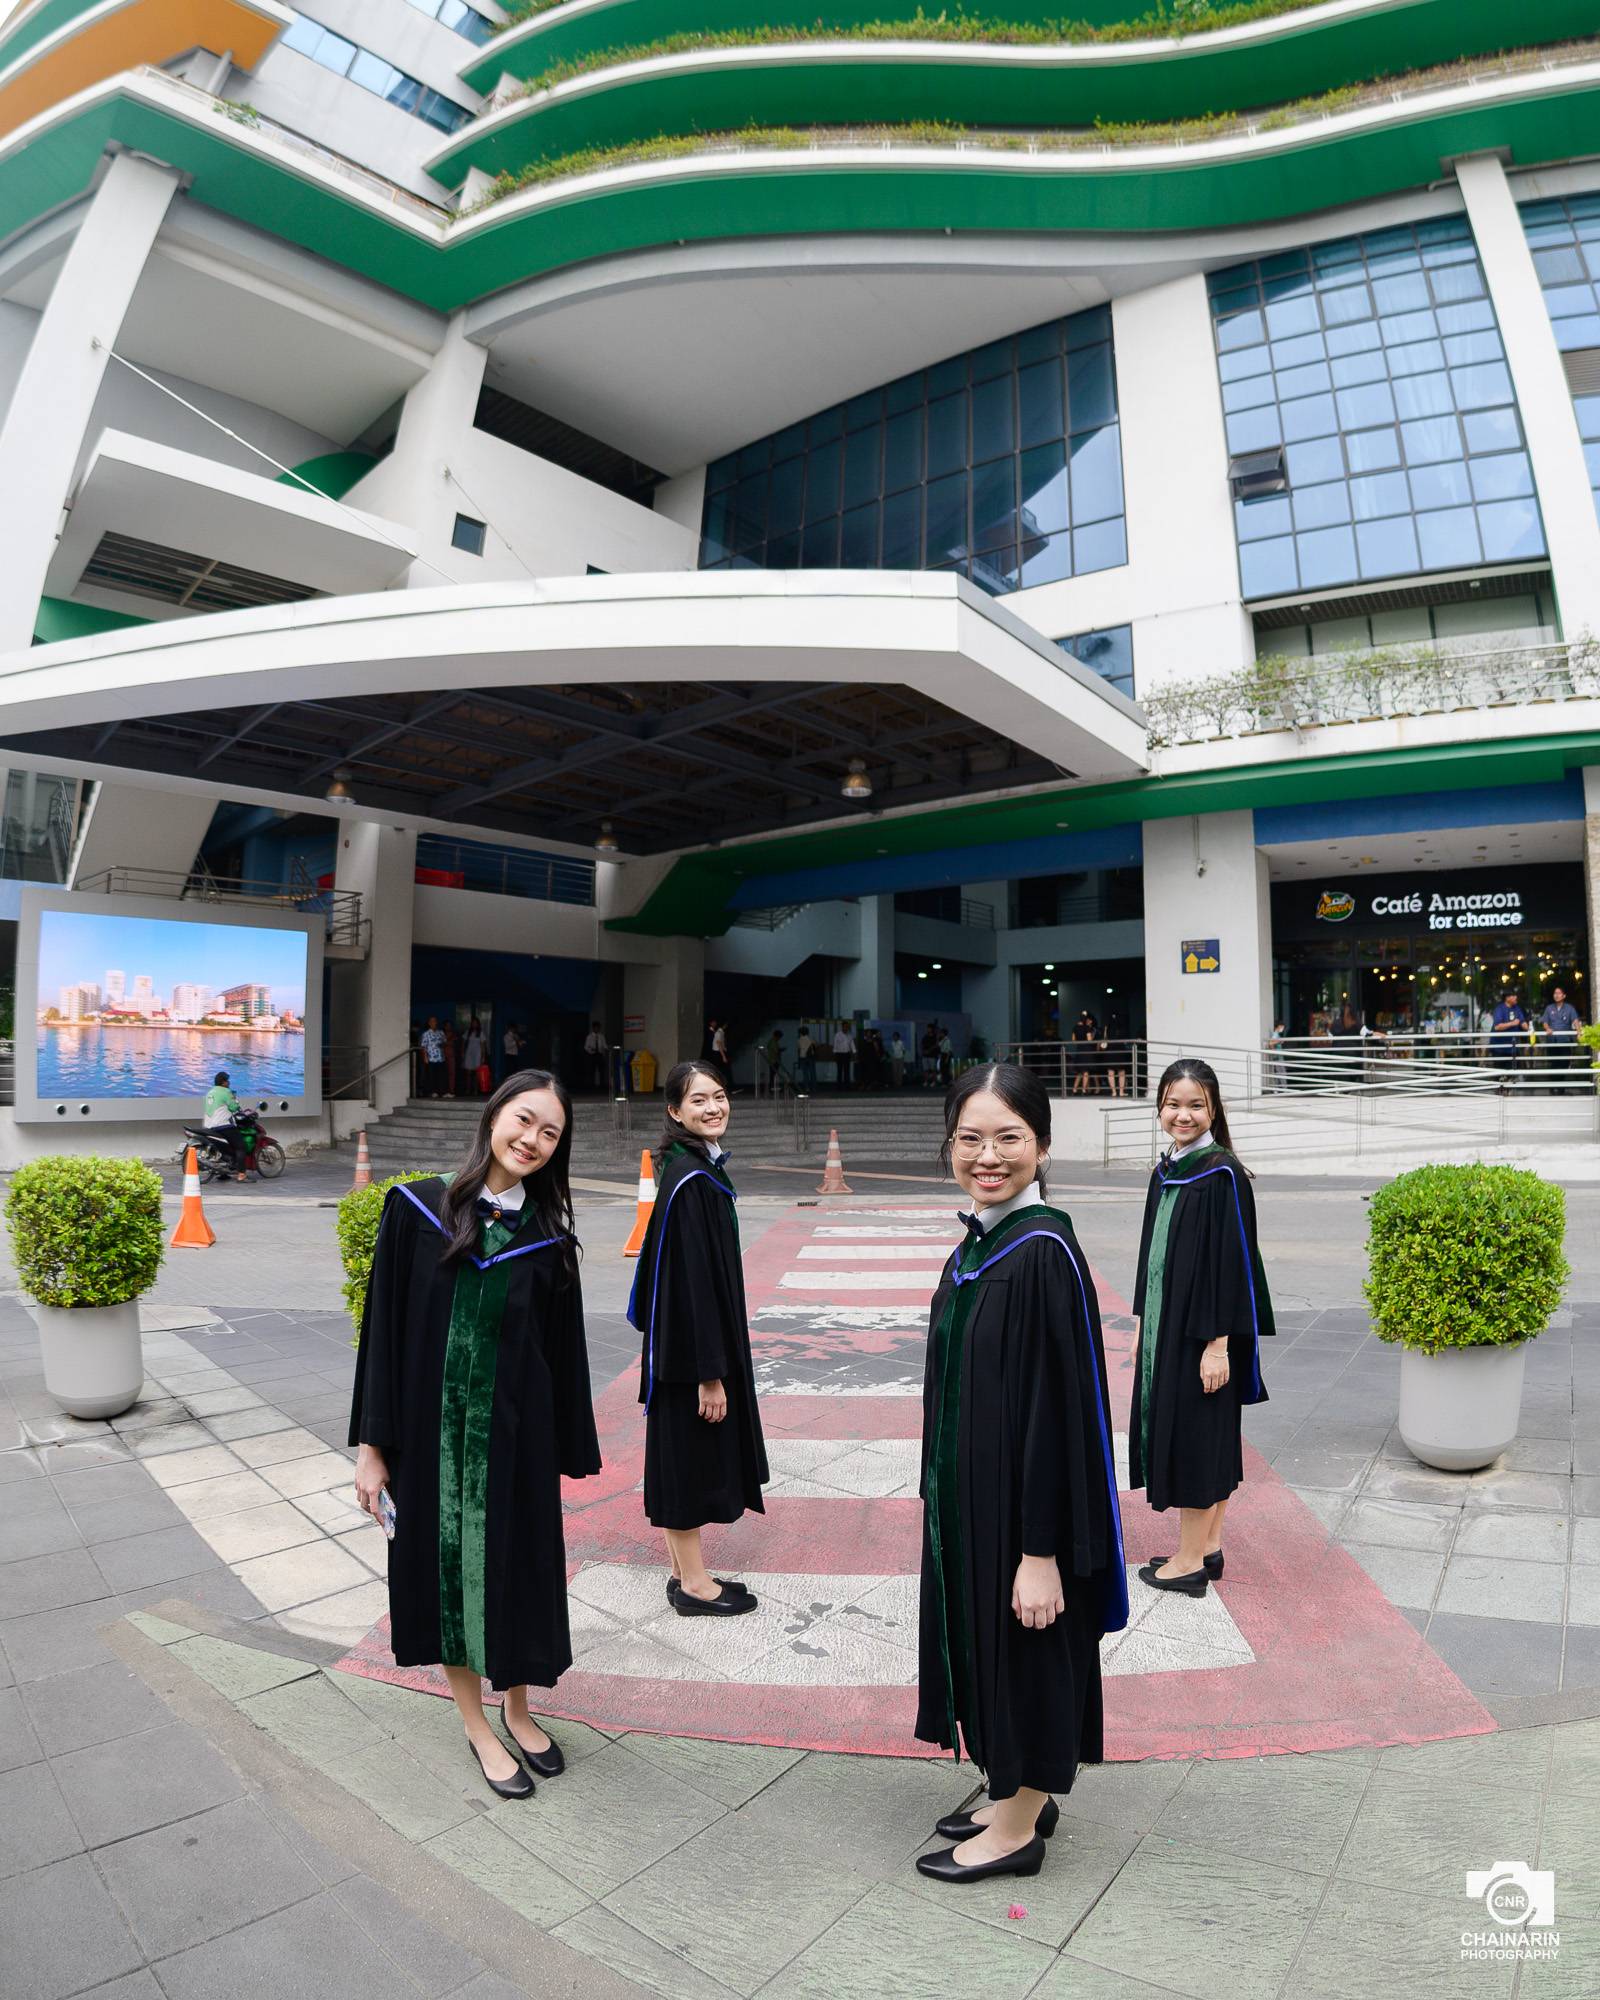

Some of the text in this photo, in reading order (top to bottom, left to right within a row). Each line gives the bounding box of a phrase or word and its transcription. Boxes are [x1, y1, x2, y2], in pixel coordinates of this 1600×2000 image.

[1371, 892, 1520, 914] Café Amazon
[1429, 912, 1522, 930] for chance
